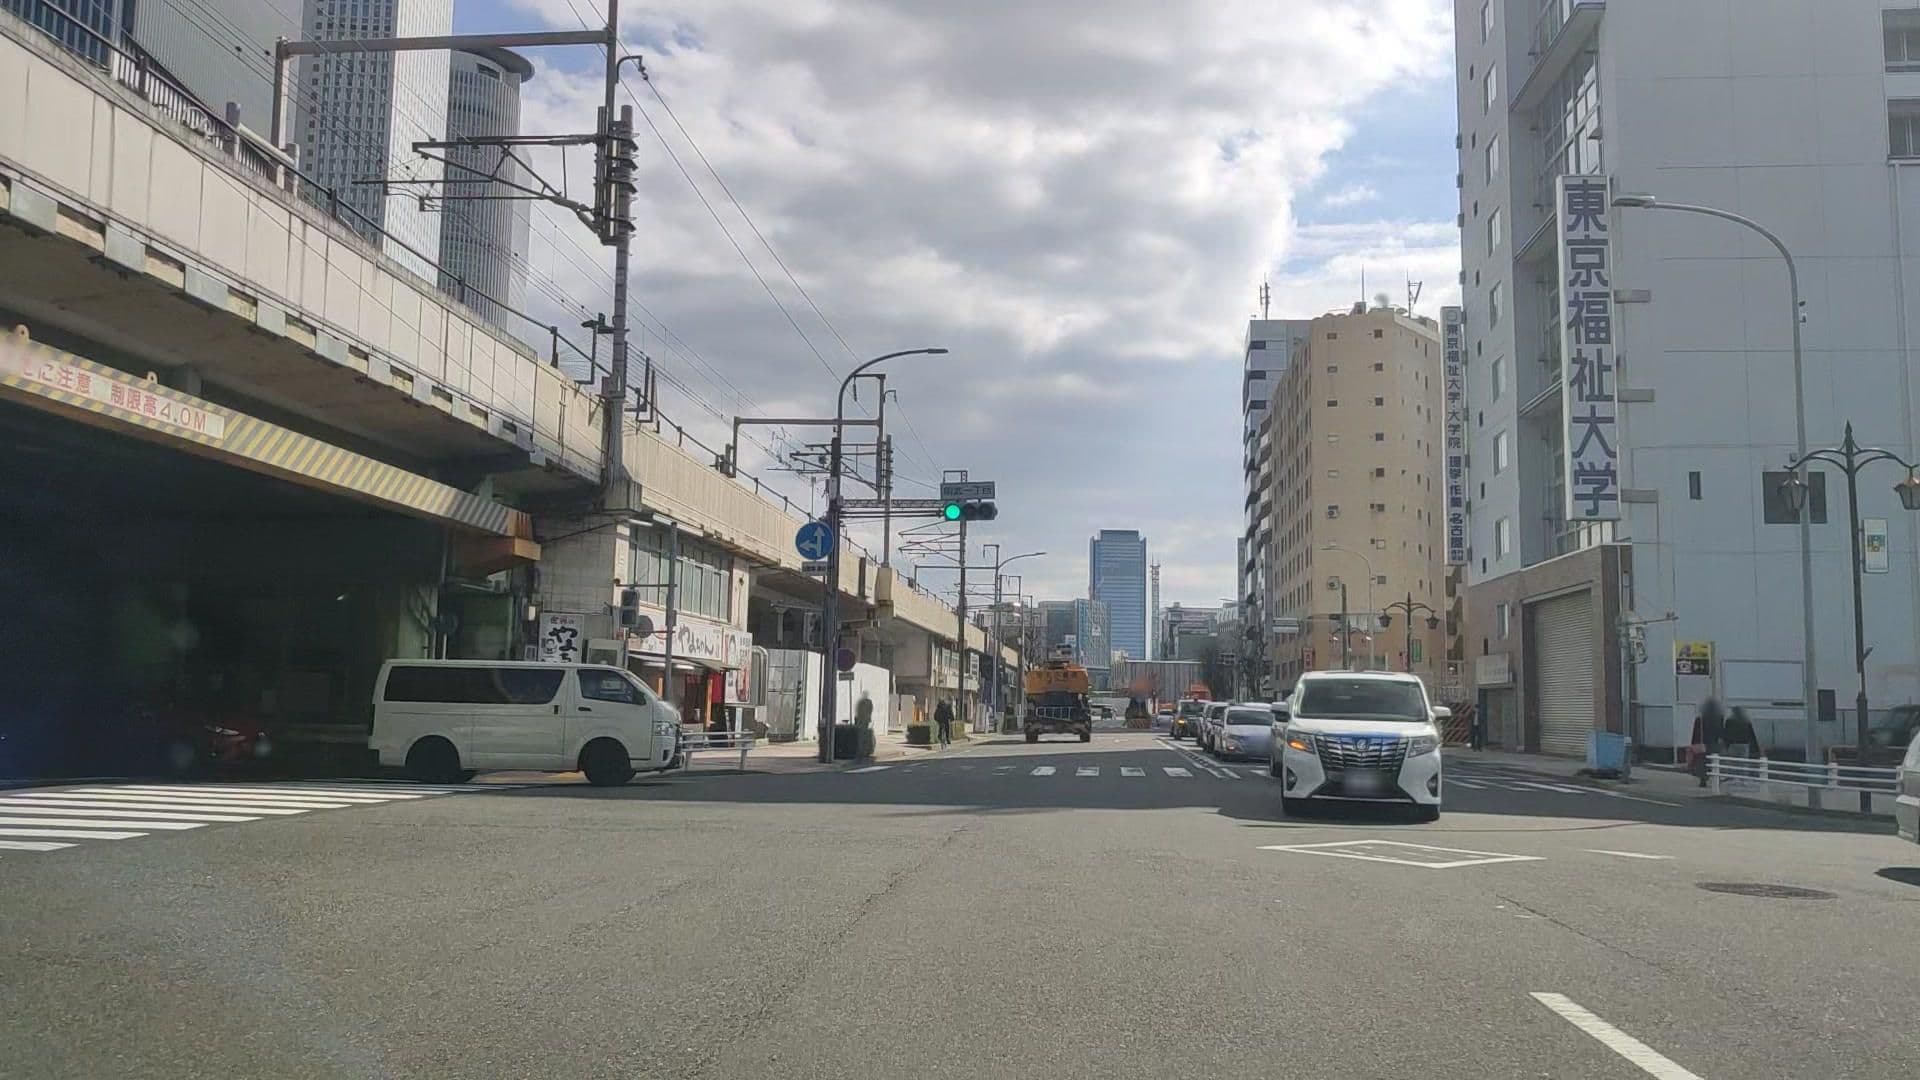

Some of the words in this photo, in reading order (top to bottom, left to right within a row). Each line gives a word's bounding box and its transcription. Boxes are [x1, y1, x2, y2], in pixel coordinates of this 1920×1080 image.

[1564, 178, 1616, 517] 東京福祉大学
